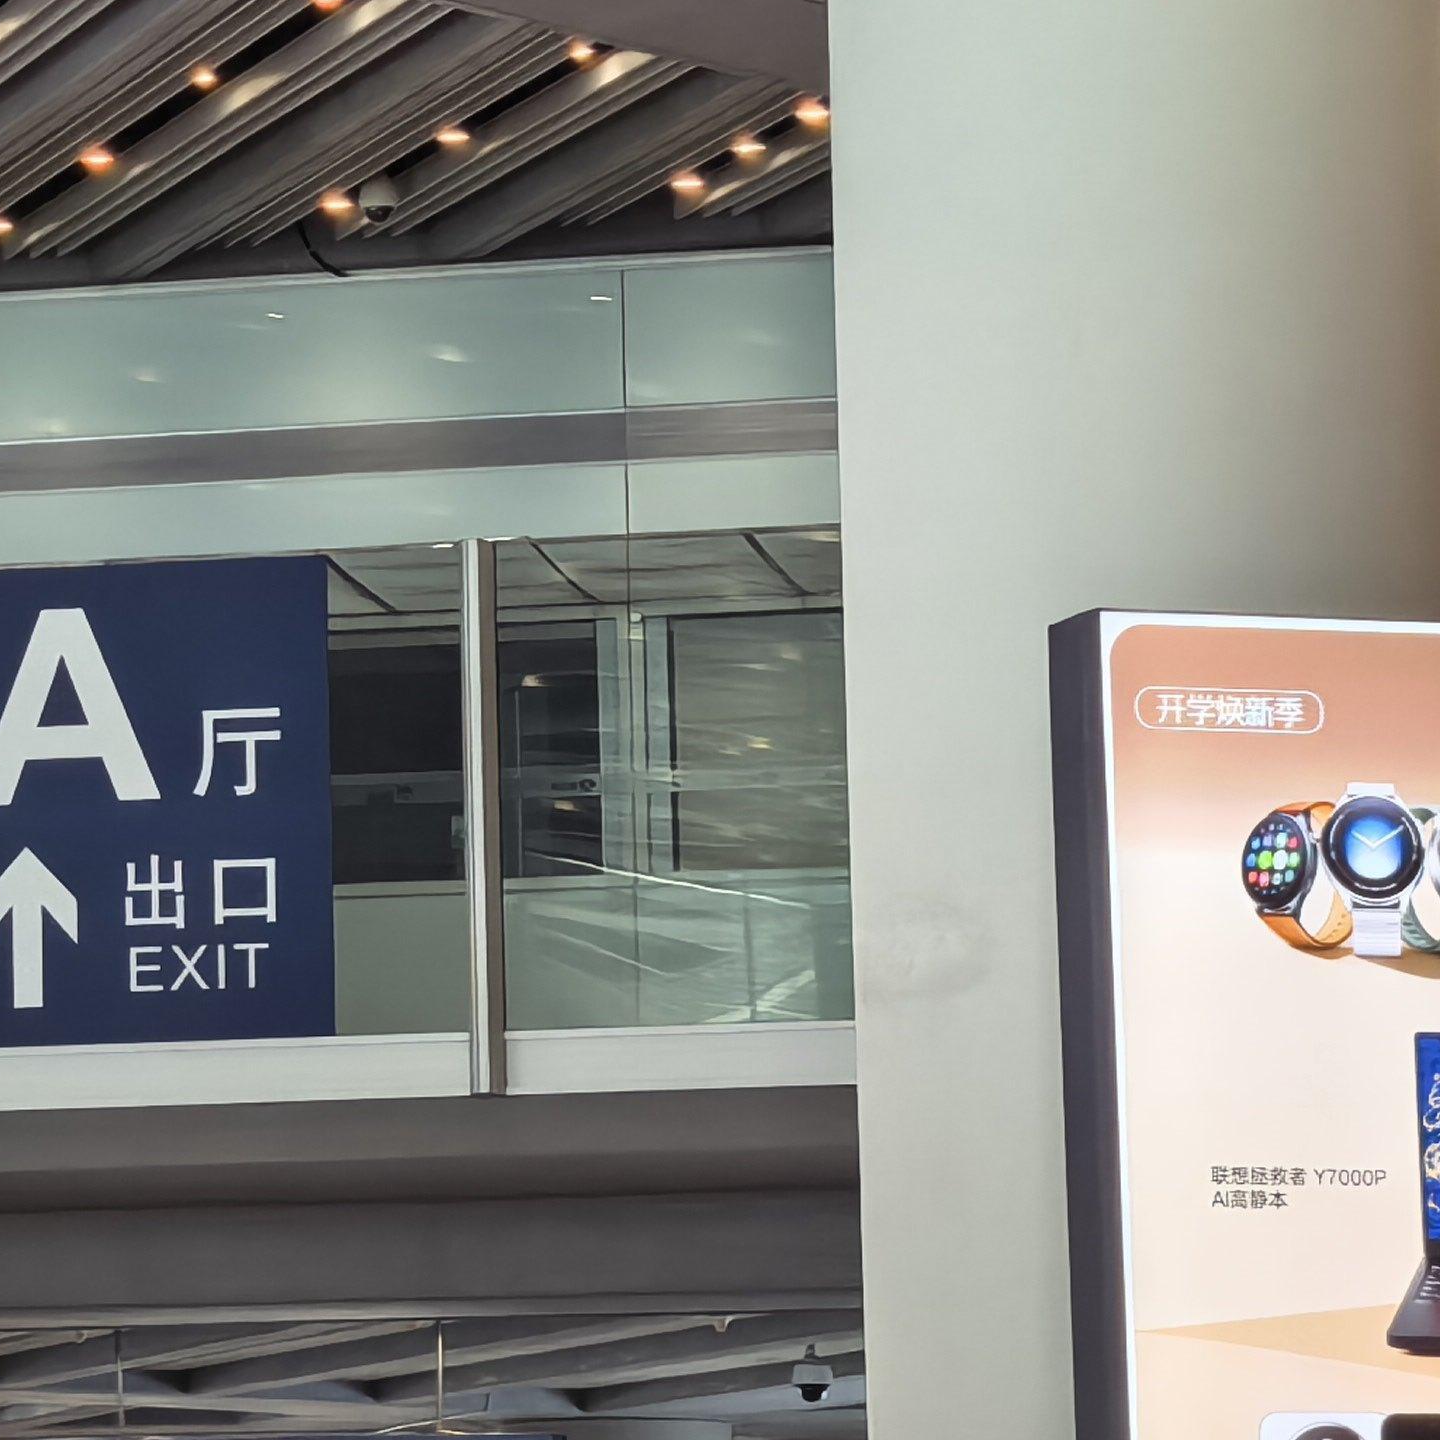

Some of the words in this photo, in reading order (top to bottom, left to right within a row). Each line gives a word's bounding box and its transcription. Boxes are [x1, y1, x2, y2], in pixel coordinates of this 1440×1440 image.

[1155, 693, 1307, 729] 开学焕新季
[191, 706, 282, 797] 厅
[124, 853, 277, 930] 出口
[129, 942, 270, 993] EXIT
[1313, 1167, 1387, 1187] Y7000P
